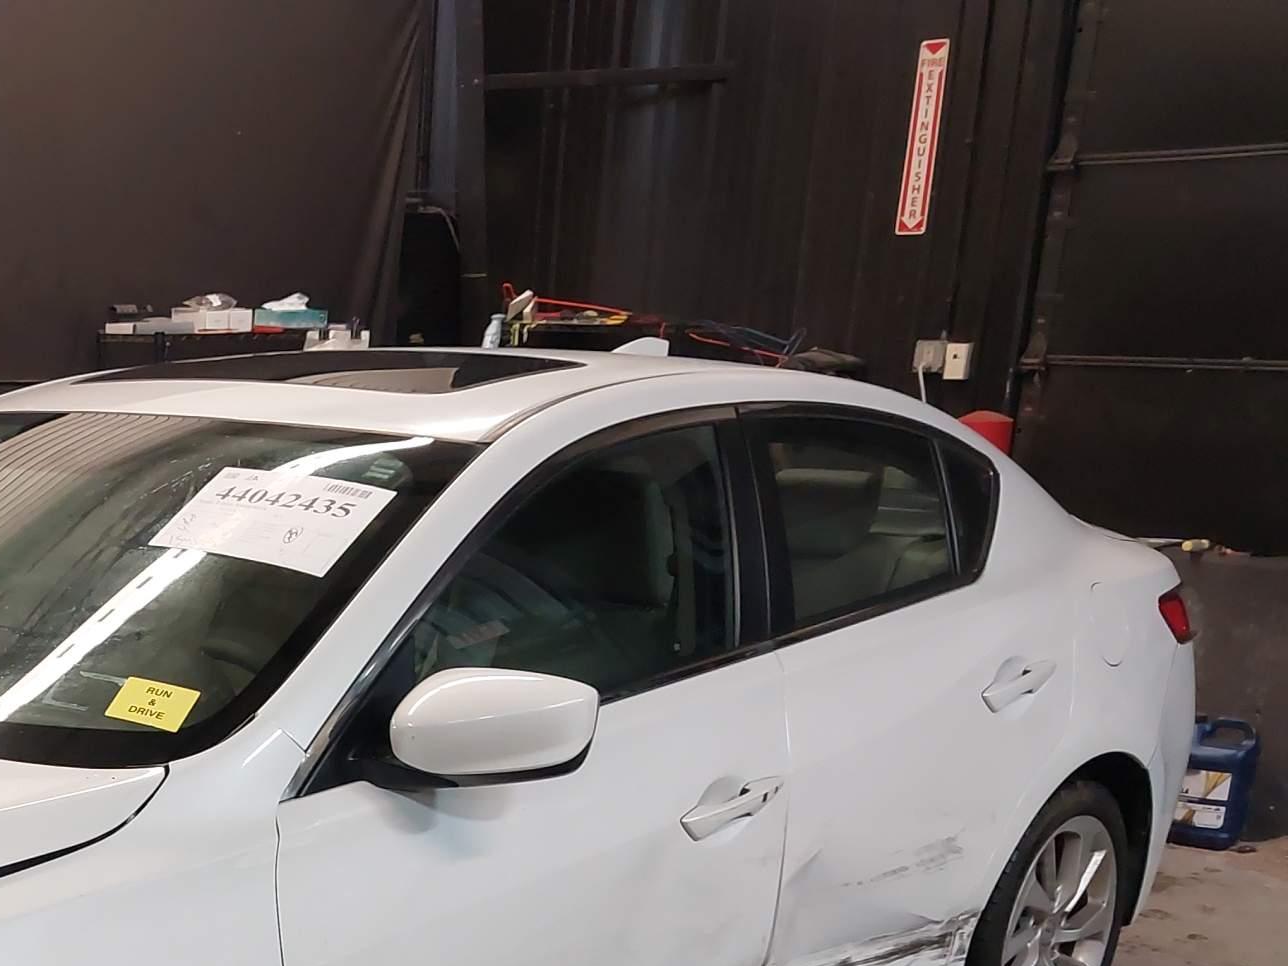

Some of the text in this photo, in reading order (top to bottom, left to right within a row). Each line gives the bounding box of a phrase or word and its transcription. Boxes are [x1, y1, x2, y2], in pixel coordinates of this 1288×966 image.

[921, 57, 945, 67] FIRE
[908, 69, 935, 220] EXTINGUISHER
[215, 486, 357, 519] 44042435
[146, 687, 173, 698] RUN
[128, 705, 166, 720] DRIVE
